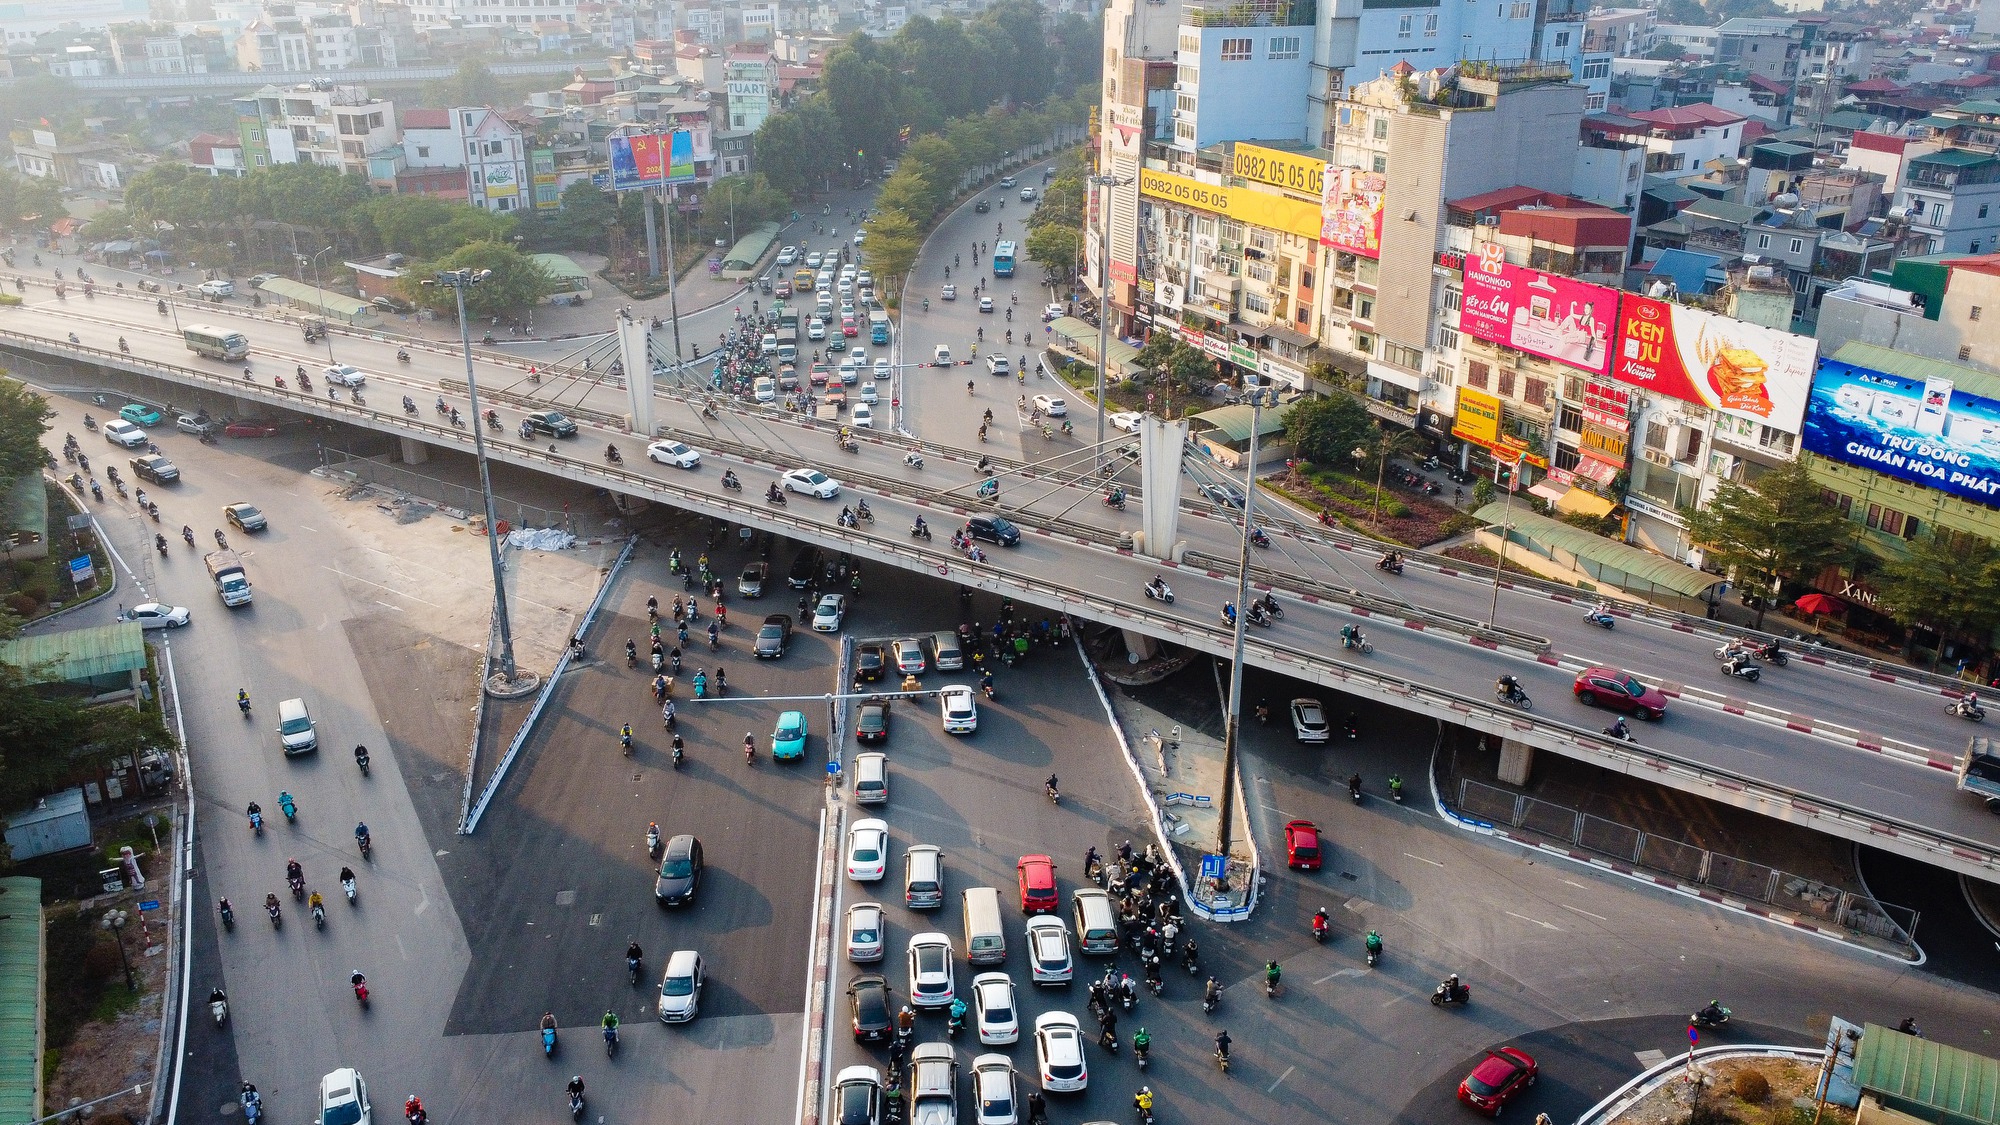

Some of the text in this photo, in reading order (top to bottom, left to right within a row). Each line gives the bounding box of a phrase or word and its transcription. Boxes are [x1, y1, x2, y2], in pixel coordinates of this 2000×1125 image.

[1236, 153, 1324, 192] 0982 05 05 05
[1143, 177, 1228, 208] 0982 05 05 05
[1468, 270, 1512, 289] HAWONKOO
[1479, 310, 1508, 324] HAWONKOO
[1627, 318, 1665, 344] KEN
[1639, 342, 1662, 363] JU
[1582, 427, 1626, 456] KÍNH MẮT
[1907, 458, 1945, 480] HÒA
[1950, 471, 2000, 495] PHÁT
